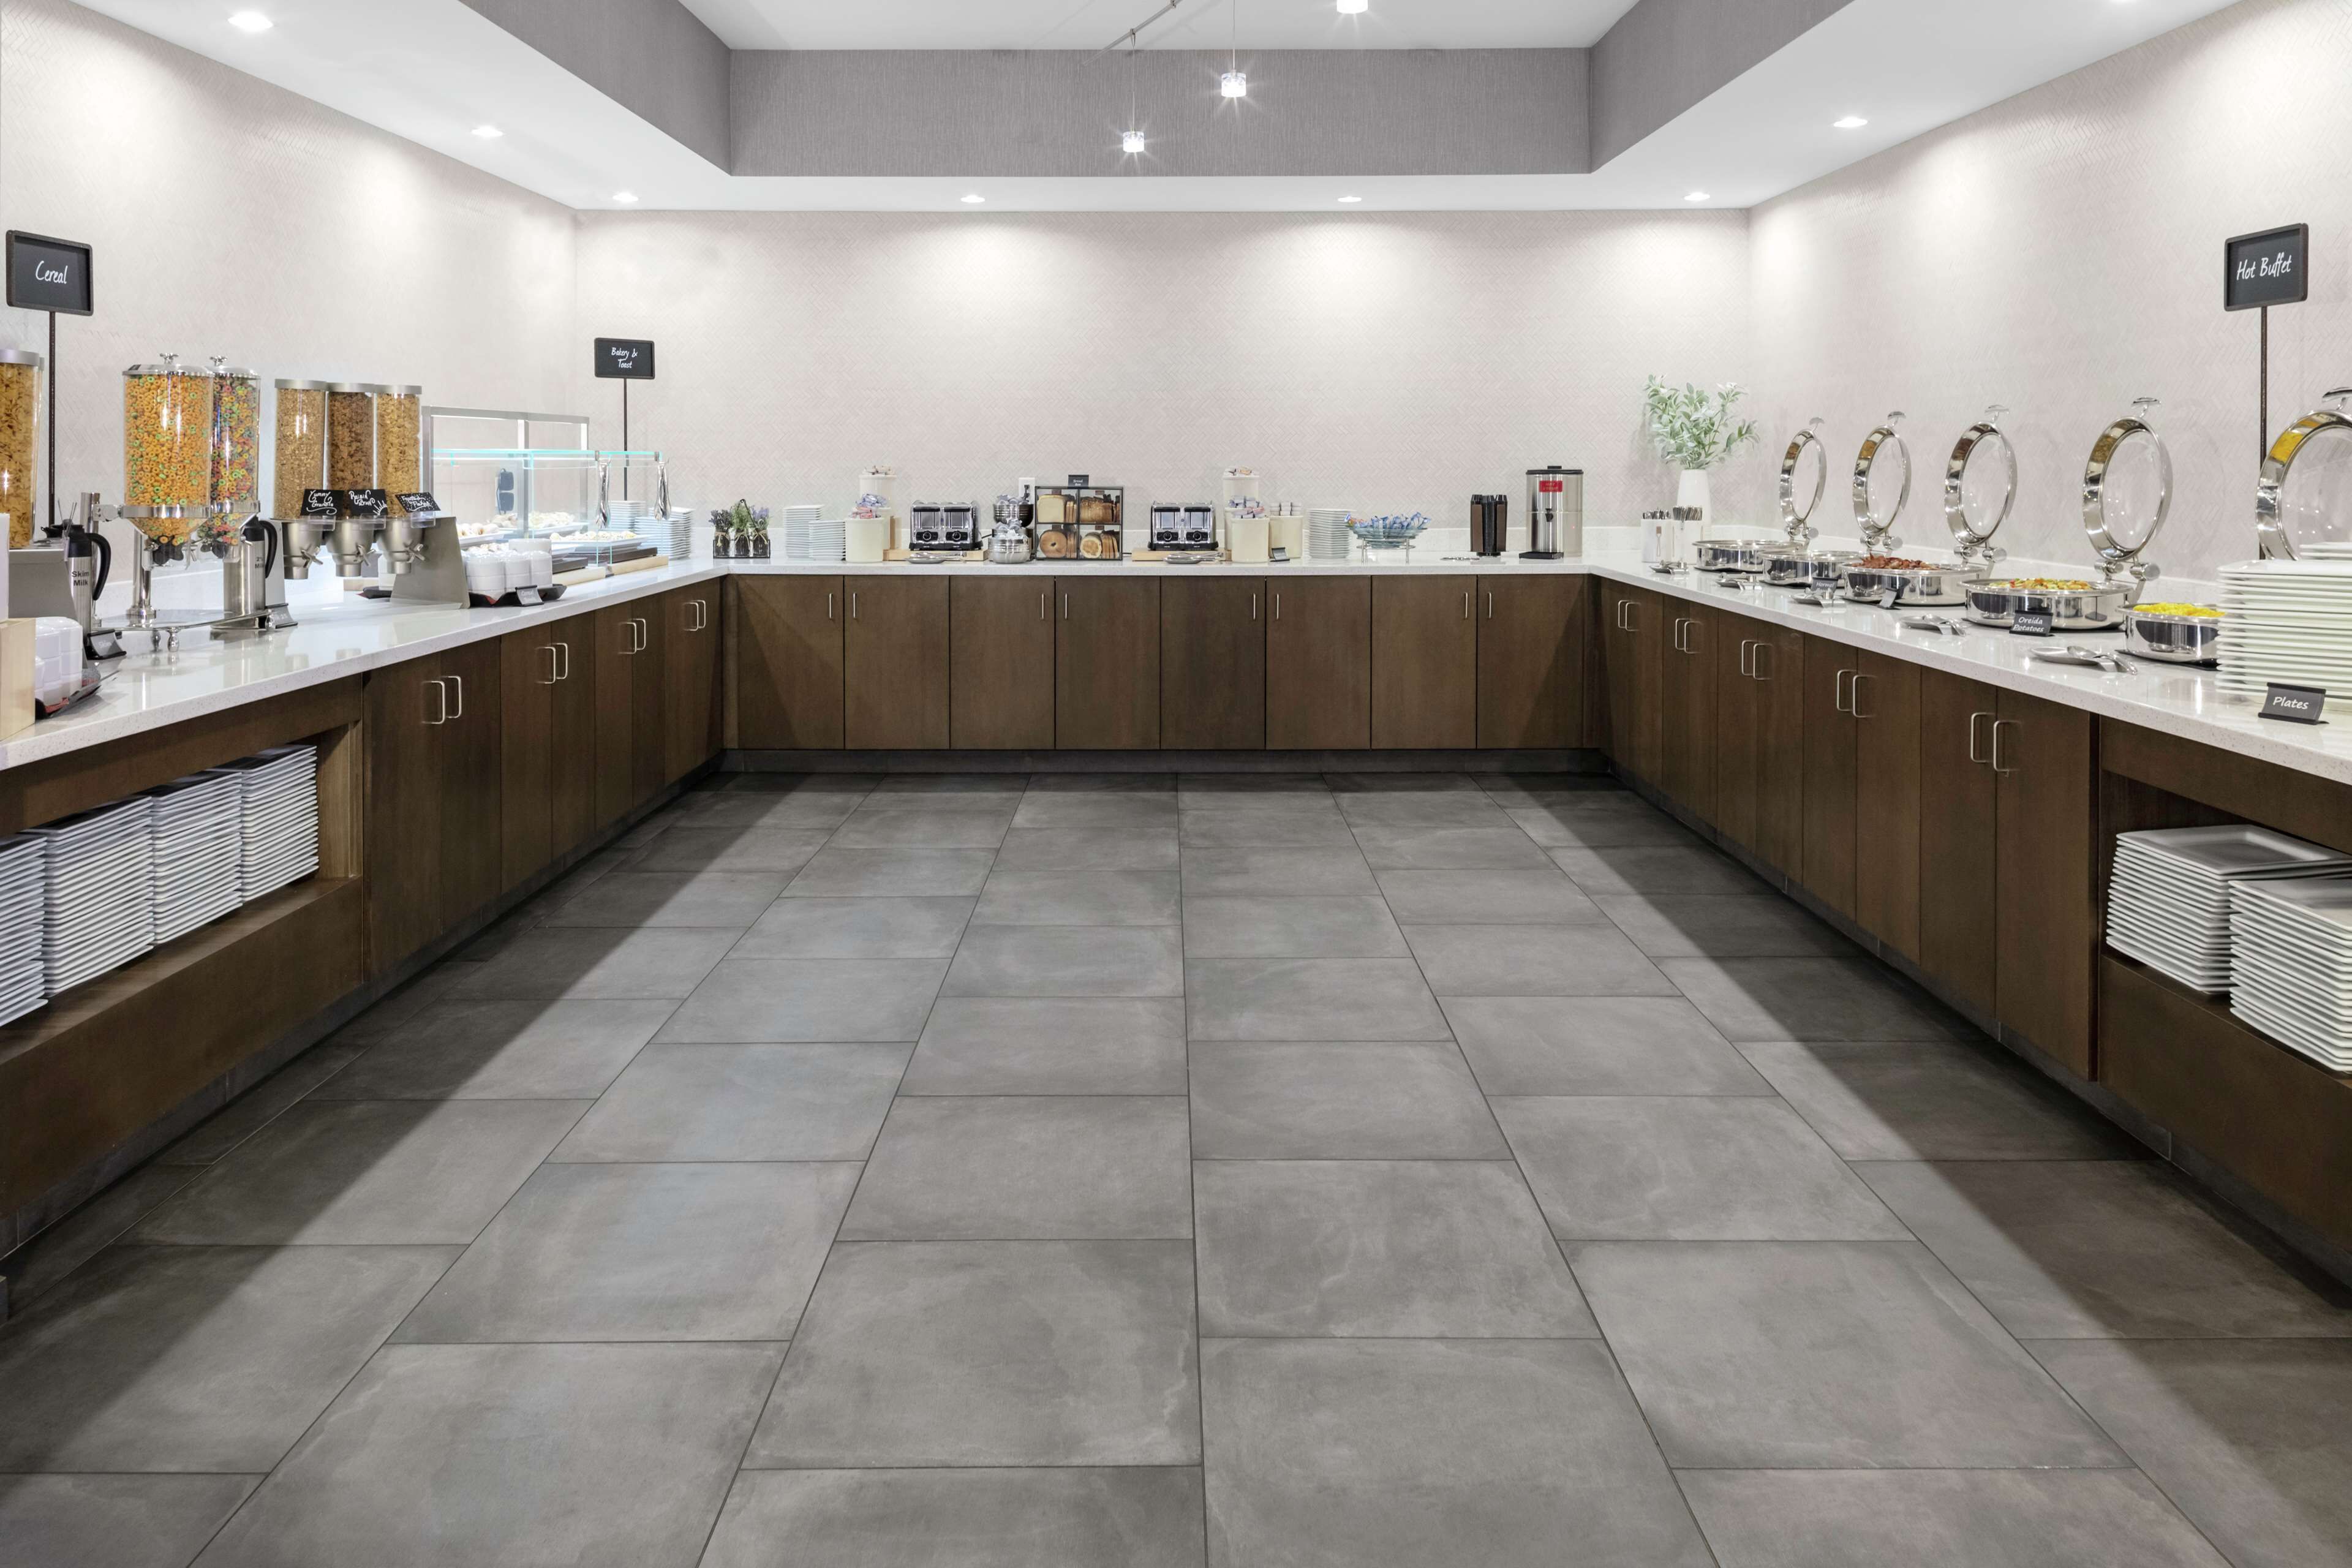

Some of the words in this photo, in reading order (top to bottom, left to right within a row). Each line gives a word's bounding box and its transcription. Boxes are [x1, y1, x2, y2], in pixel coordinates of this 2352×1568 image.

[35, 260, 69, 284] Cereal
[2236, 258, 2256, 281] Hot
[2259, 251, 2293, 277] Buffet
[611, 347, 630, 360] Bakery
[631, 348, 638, 358] &
[617, 358, 632, 369] Toast
[308, 490, 333, 503] Yummy
[349, 490, 371, 501] Raisin
[2018, 616, 2043, 625] Oreida
[2272, 696, 2309, 710] Plates
